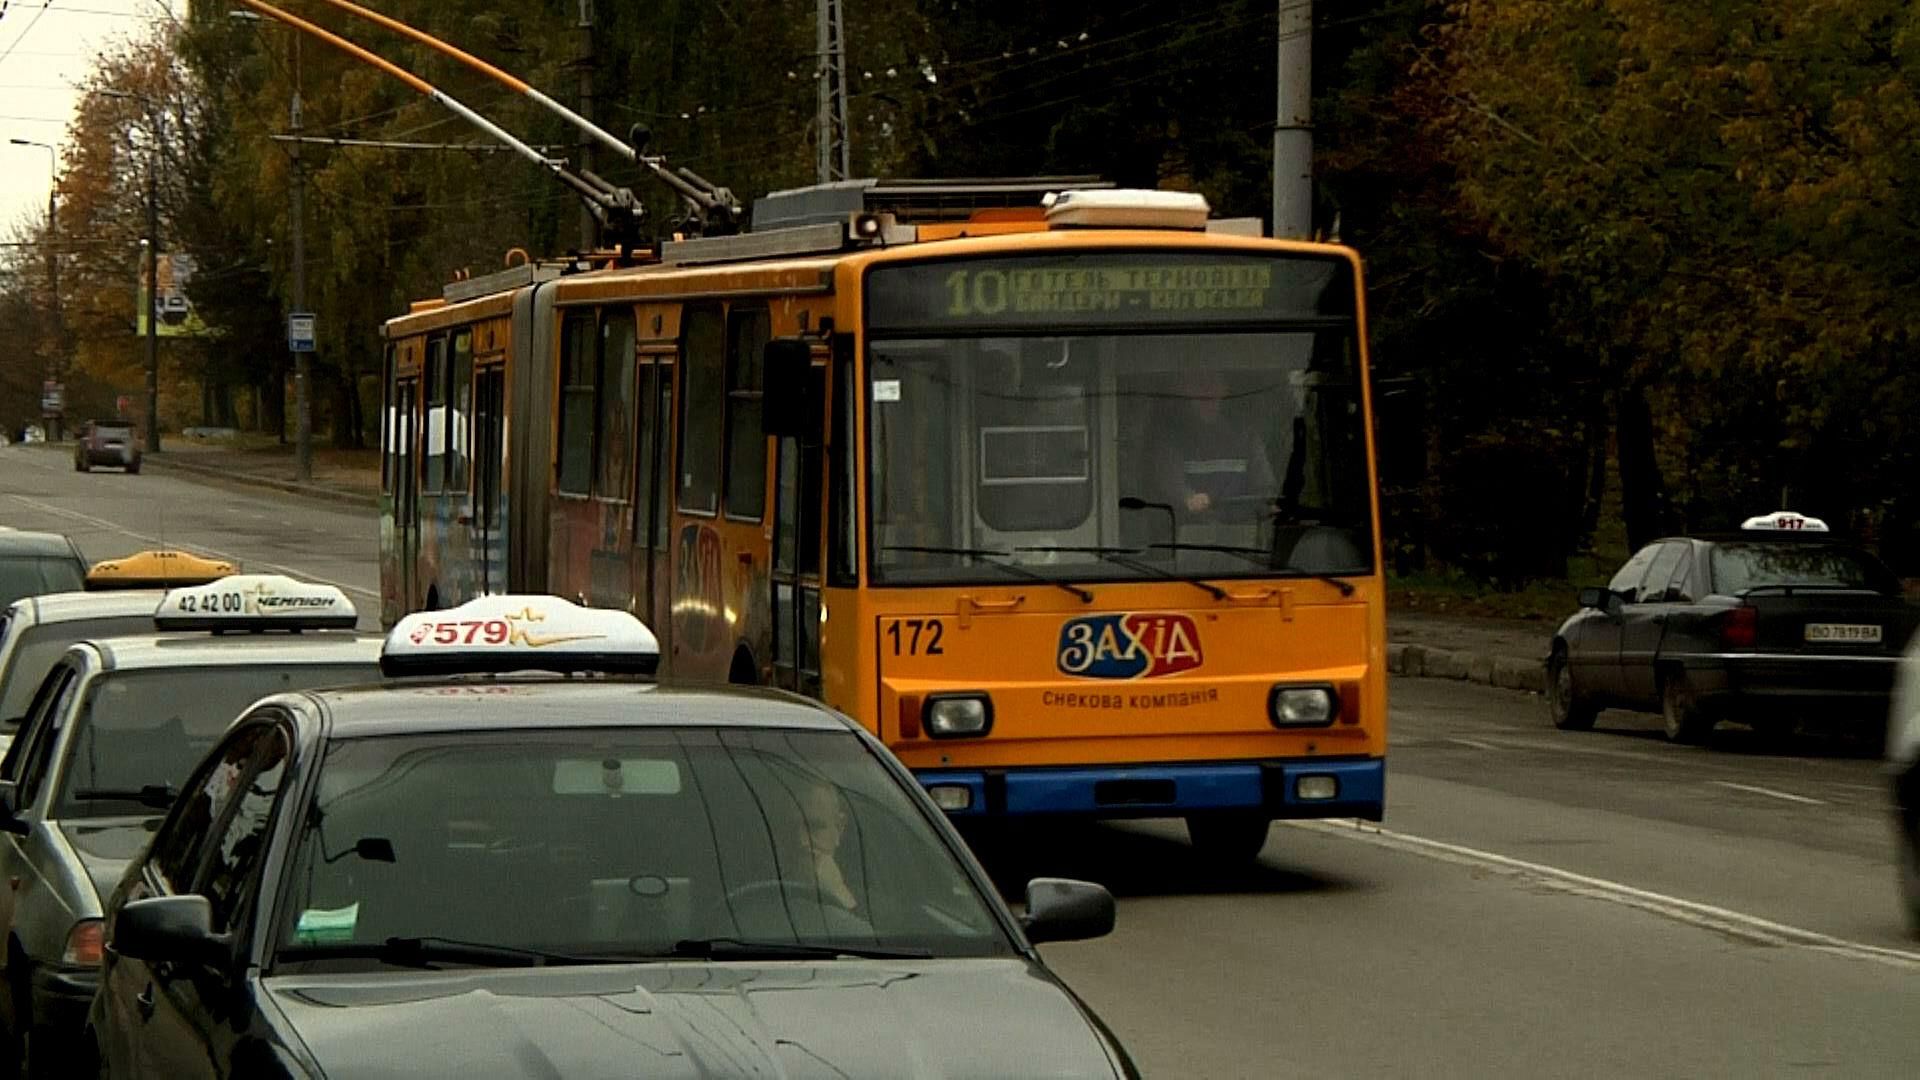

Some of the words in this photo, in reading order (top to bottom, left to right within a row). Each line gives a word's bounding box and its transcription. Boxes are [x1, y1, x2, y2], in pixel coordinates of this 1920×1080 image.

[946, 270, 1008, 316] 10
[1777, 518, 1804, 529] 917
[179, 595, 197, 612] 42
[201, 594, 219, 612] 42
[223, 593, 241, 612] 00
[434, 621, 507, 645] 579
[887, 619, 944, 656] 172
[1128, 688, 1219, 709] компанія
